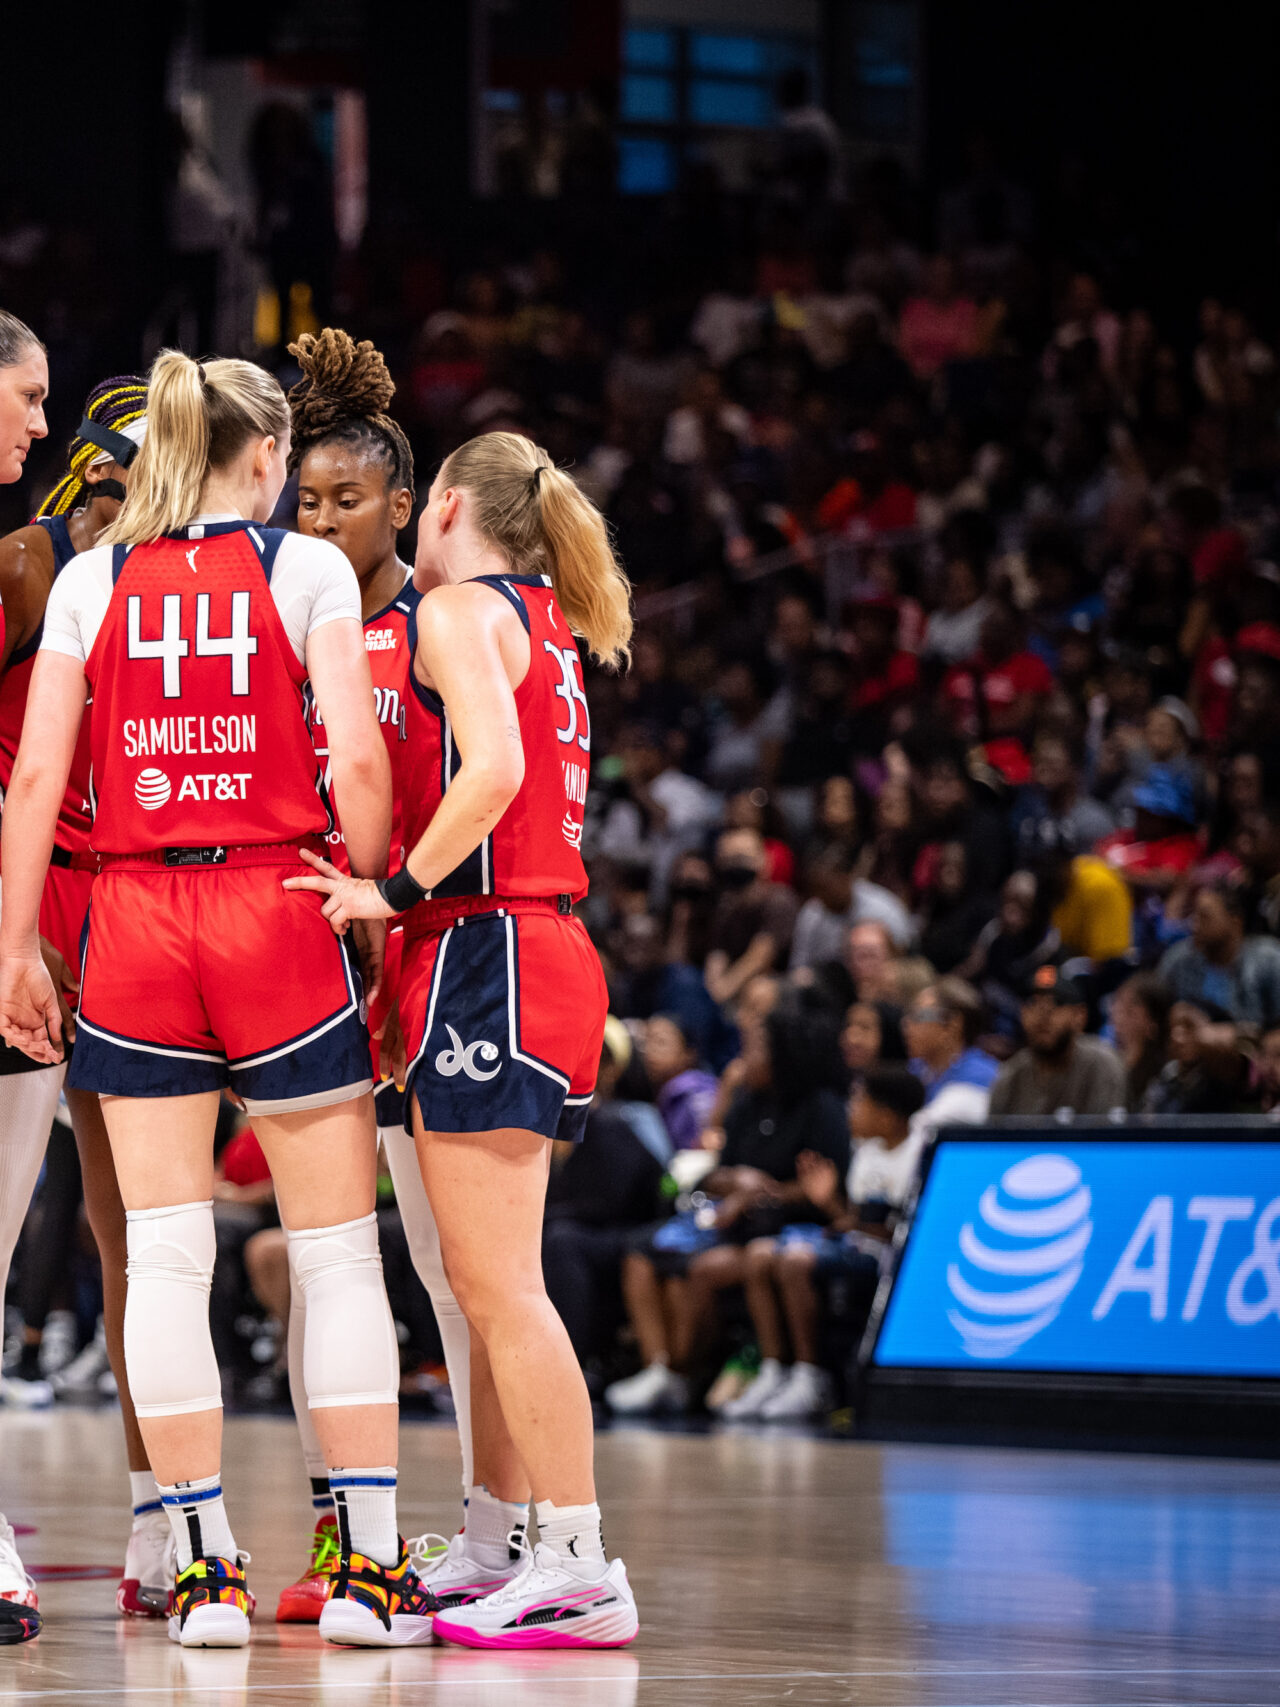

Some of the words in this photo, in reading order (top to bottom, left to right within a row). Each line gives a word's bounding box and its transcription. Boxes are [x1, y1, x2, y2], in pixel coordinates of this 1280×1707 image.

[127, 590, 258, 698] 44
[365, 629, 394, 641] CAR
[365, 638, 397, 652] max
[543, 640, 590, 752] 35
[123, 714, 256, 757] SAMUELSON
[177, 773, 252, 801] AT&T
[1091, 1195, 1280, 1325] AT&
